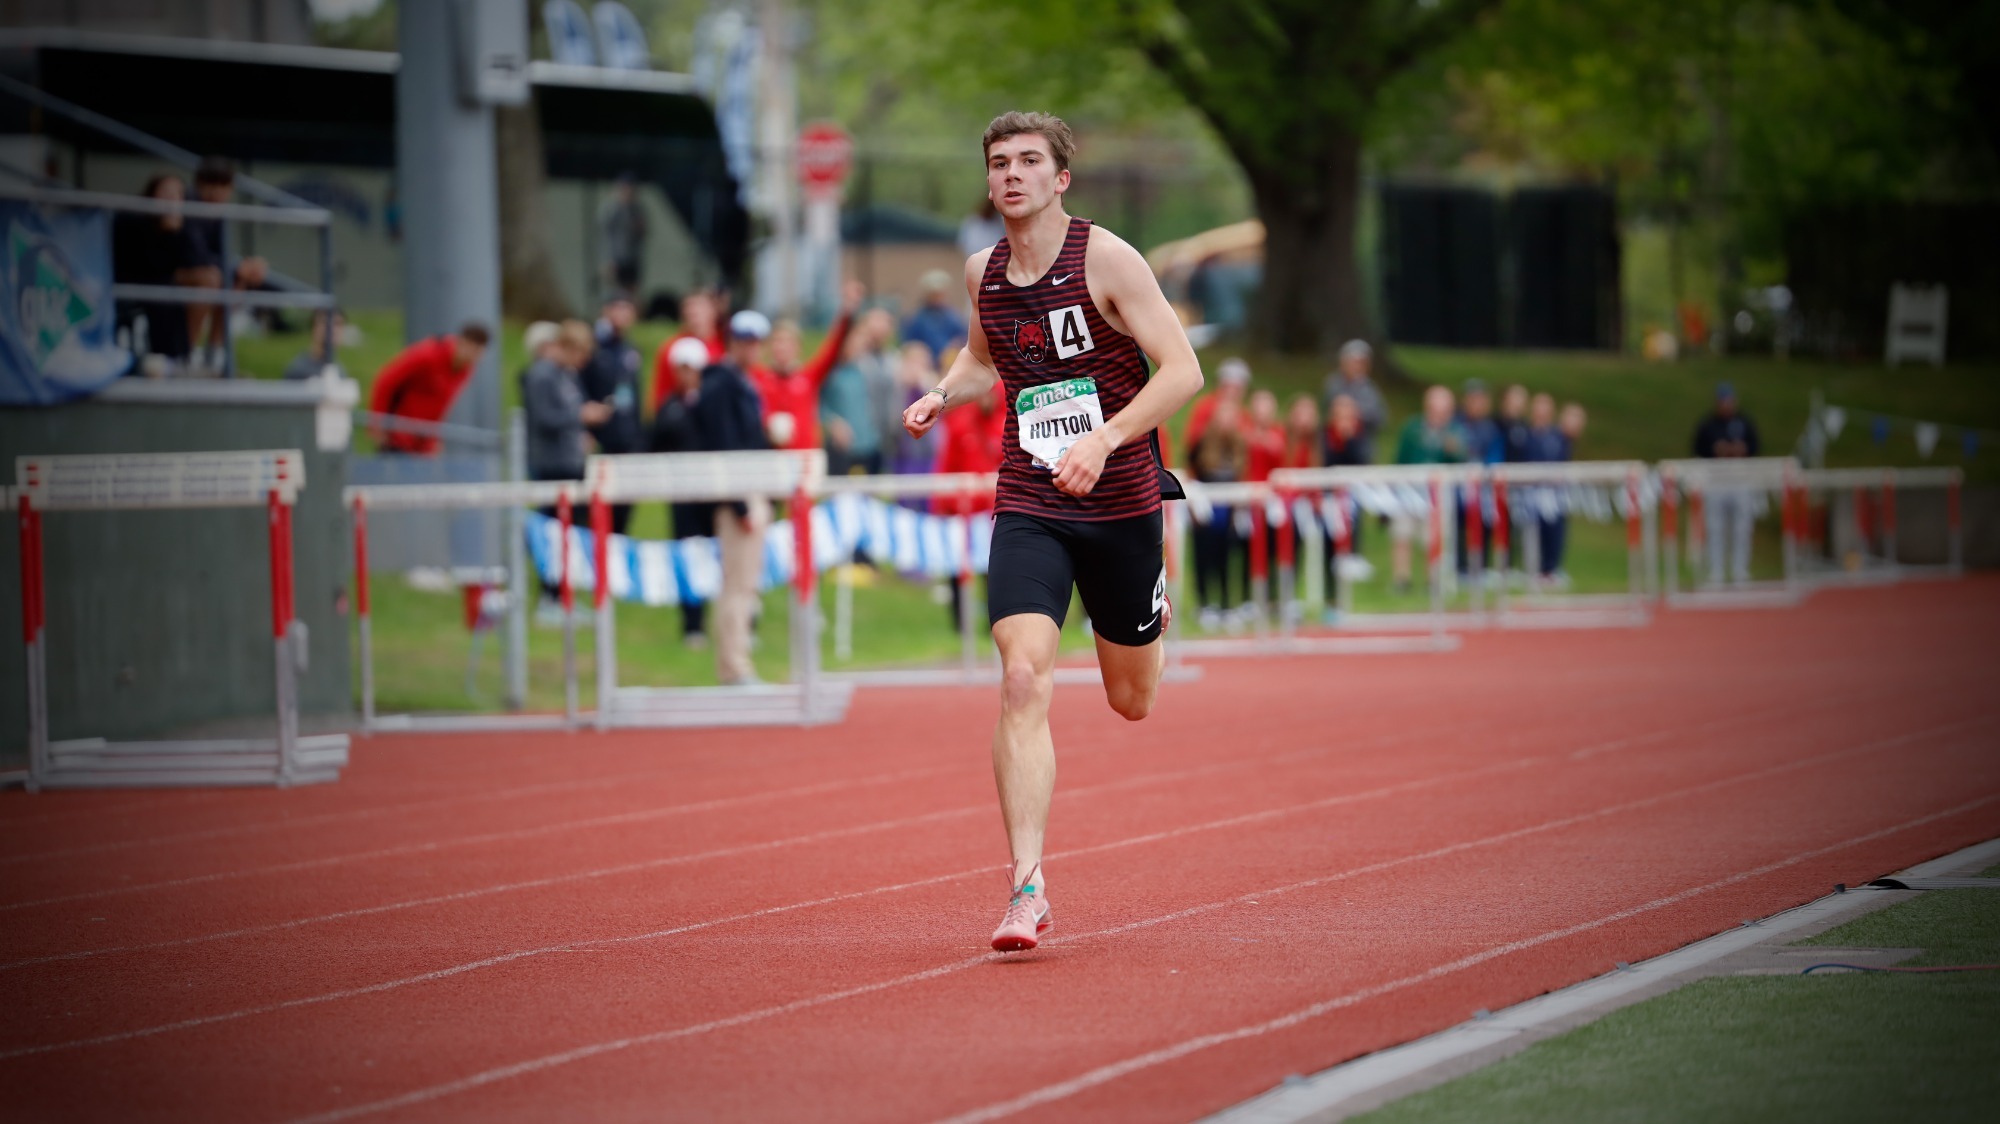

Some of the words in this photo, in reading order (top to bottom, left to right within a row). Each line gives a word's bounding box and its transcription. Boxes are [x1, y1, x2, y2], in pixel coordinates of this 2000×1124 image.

[1061, 310, 1086, 351] 4
[1032, 383, 1076, 412] gnac
[1030, 413, 1093, 440] HUTTON
